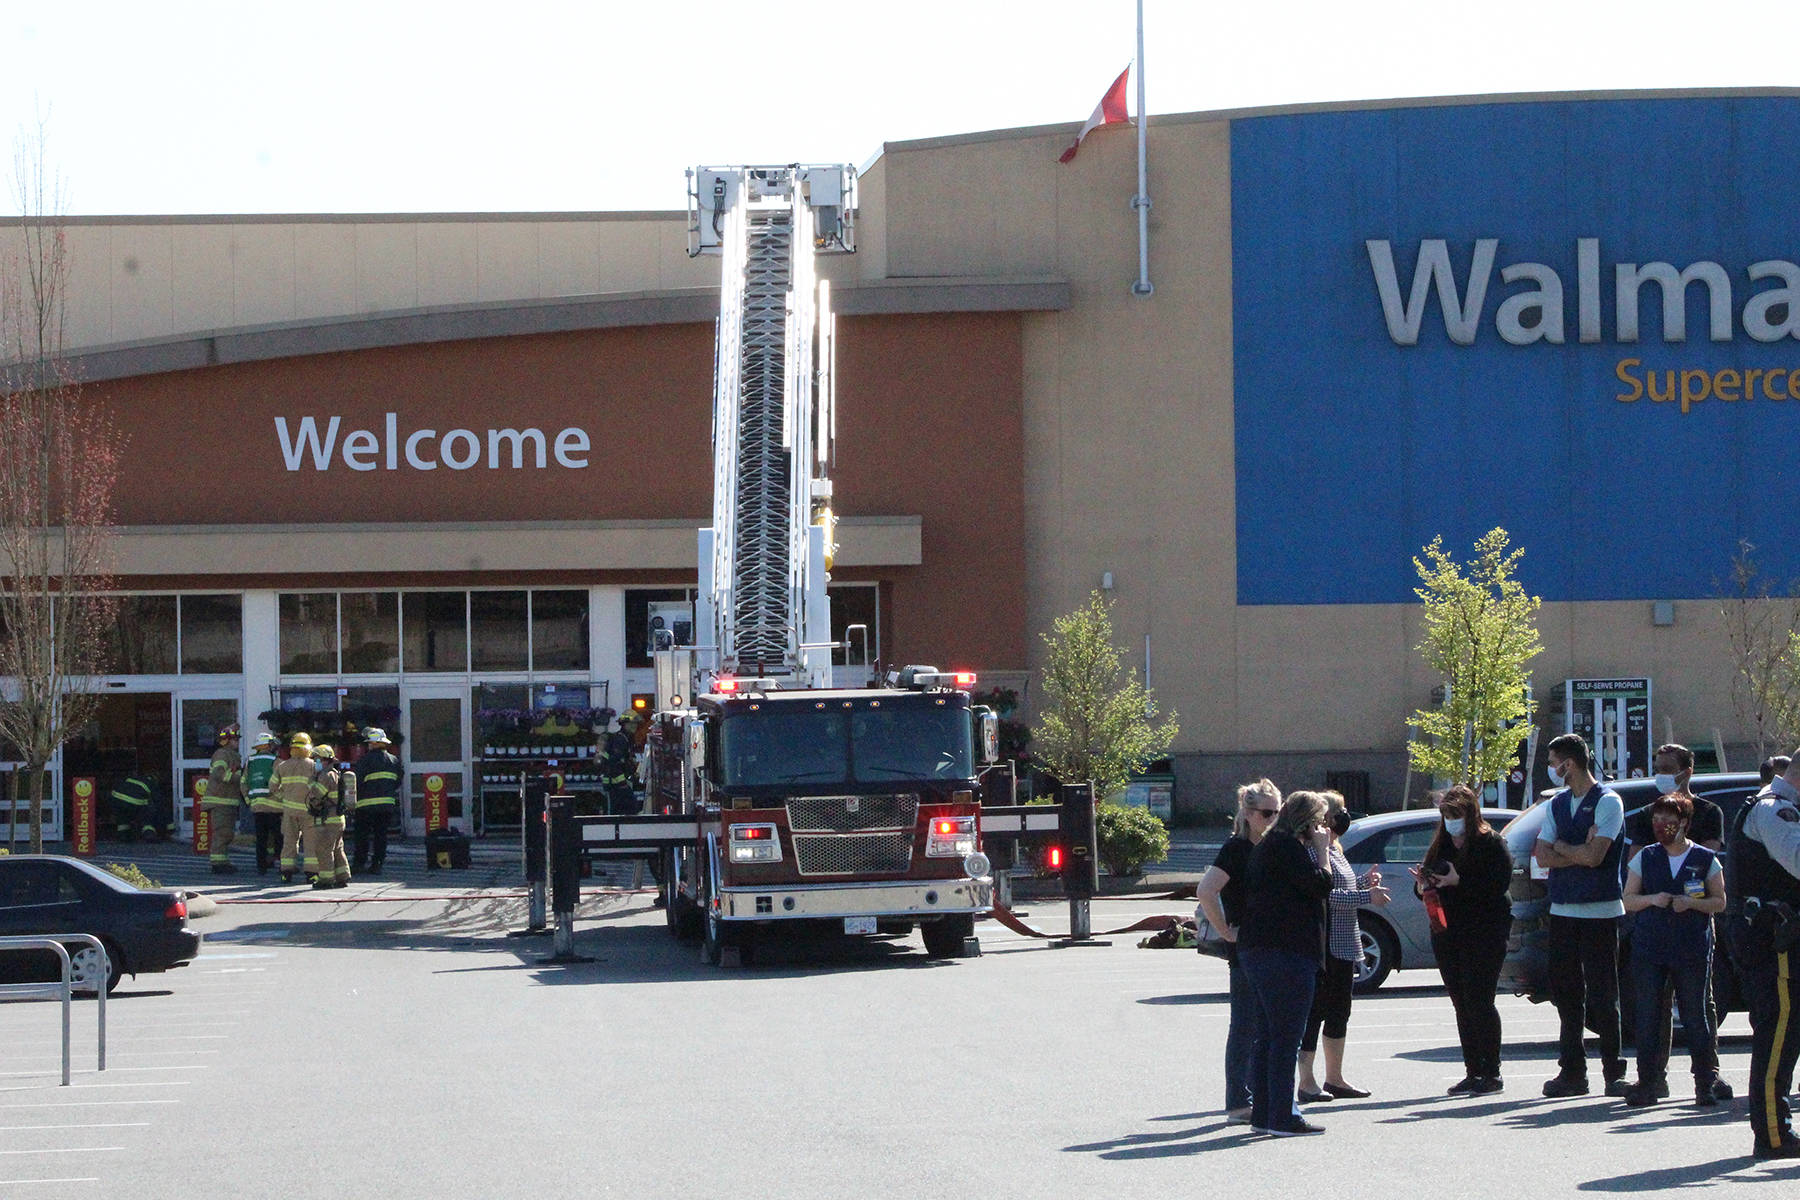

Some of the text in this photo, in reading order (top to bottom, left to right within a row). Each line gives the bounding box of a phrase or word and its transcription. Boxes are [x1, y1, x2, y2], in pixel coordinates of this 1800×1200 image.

[1365, 237, 1800, 346] Walma
[273, 412, 591, 471] Welcome
[1576, 681, 1643, 690] SELF-SERVE PROPANE
[77, 798, 89, 853] Rollback
[197, 796, 208, 851] Rollba
[429, 793, 440, 831] llback
